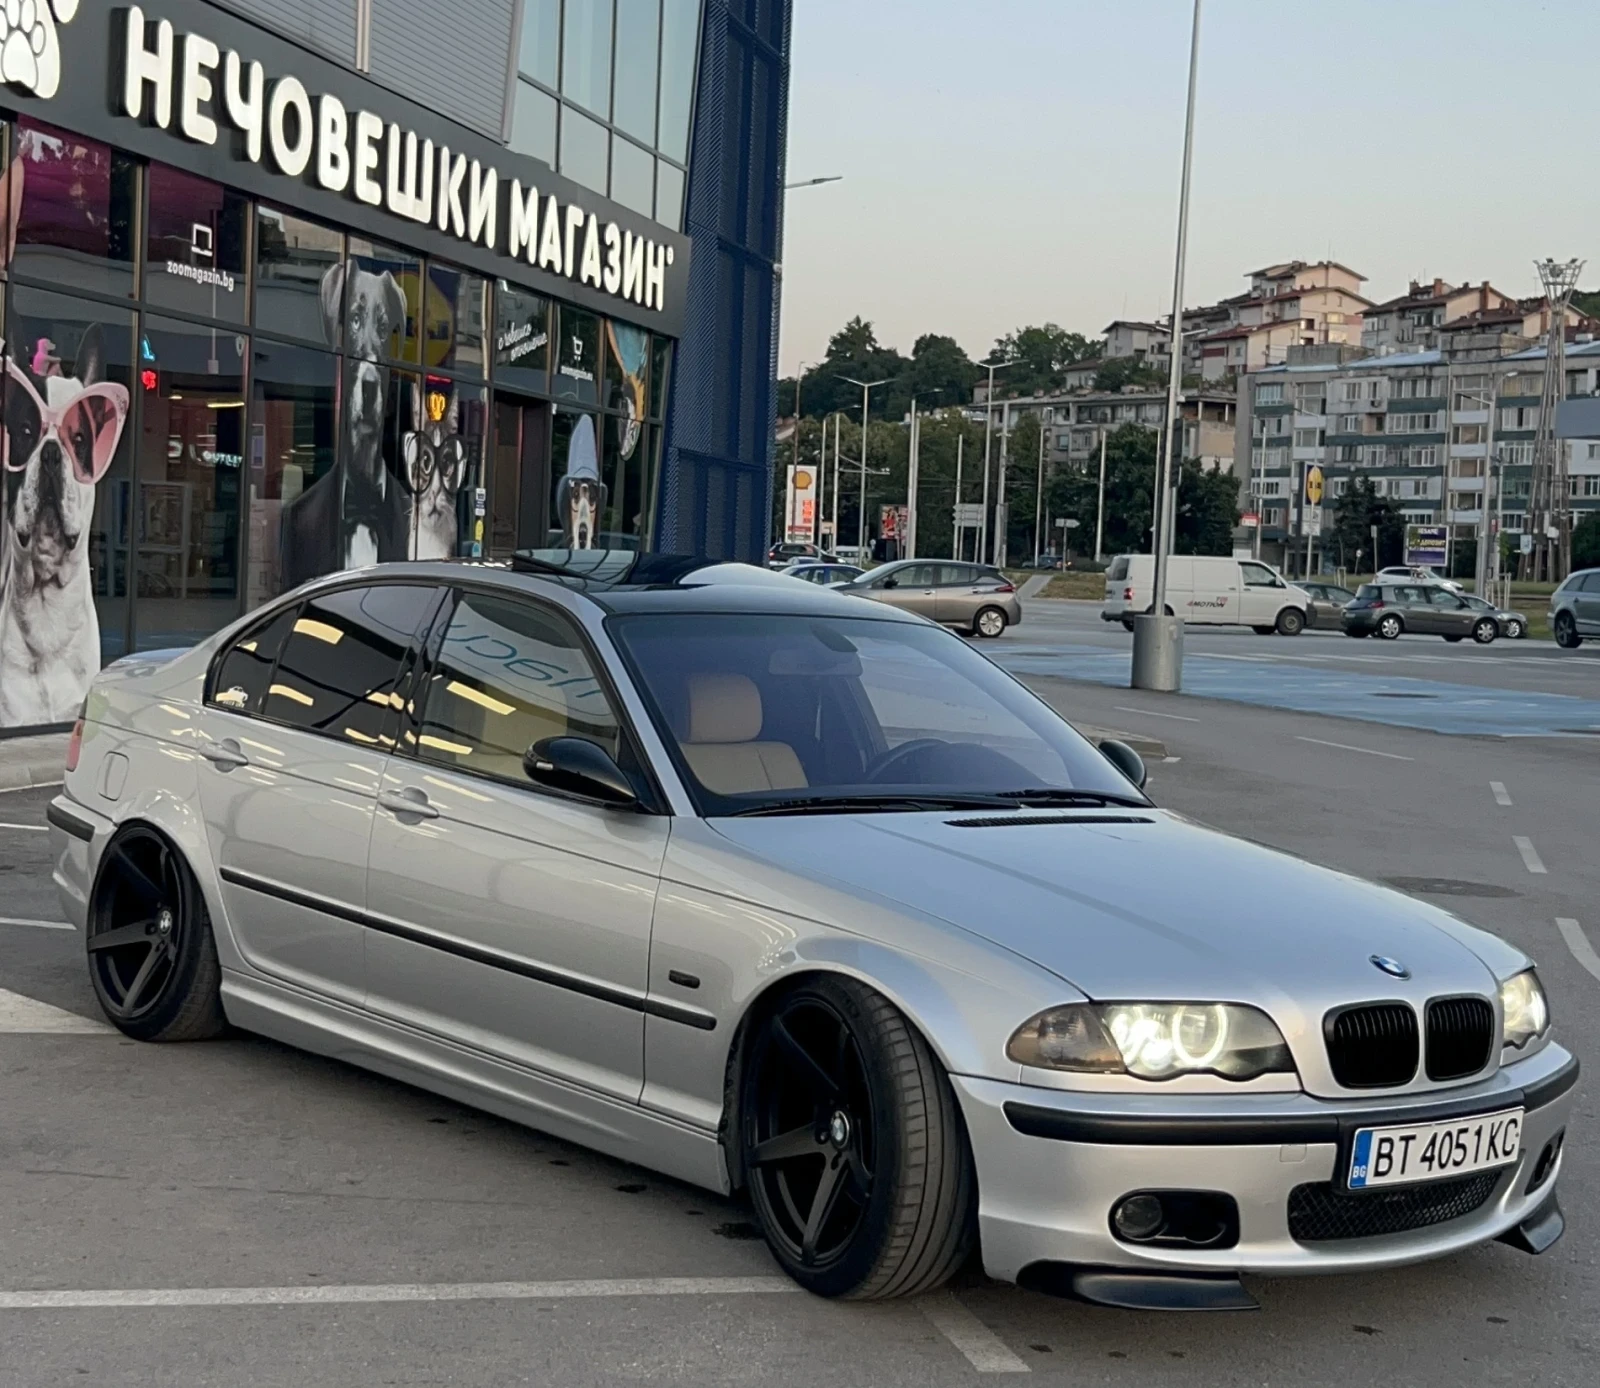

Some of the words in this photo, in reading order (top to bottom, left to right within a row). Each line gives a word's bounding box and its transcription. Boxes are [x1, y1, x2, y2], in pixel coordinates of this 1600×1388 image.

[124, 5, 498, 250] НЕЧОВЕШКИ
[509, 177, 667, 312] МАГАЗИН
[166, 260, 235, 292] zoomagazin.bg
[1351, 1164, 1367, 1179] BG
[1373, 1134, 1417, 1178] BT
